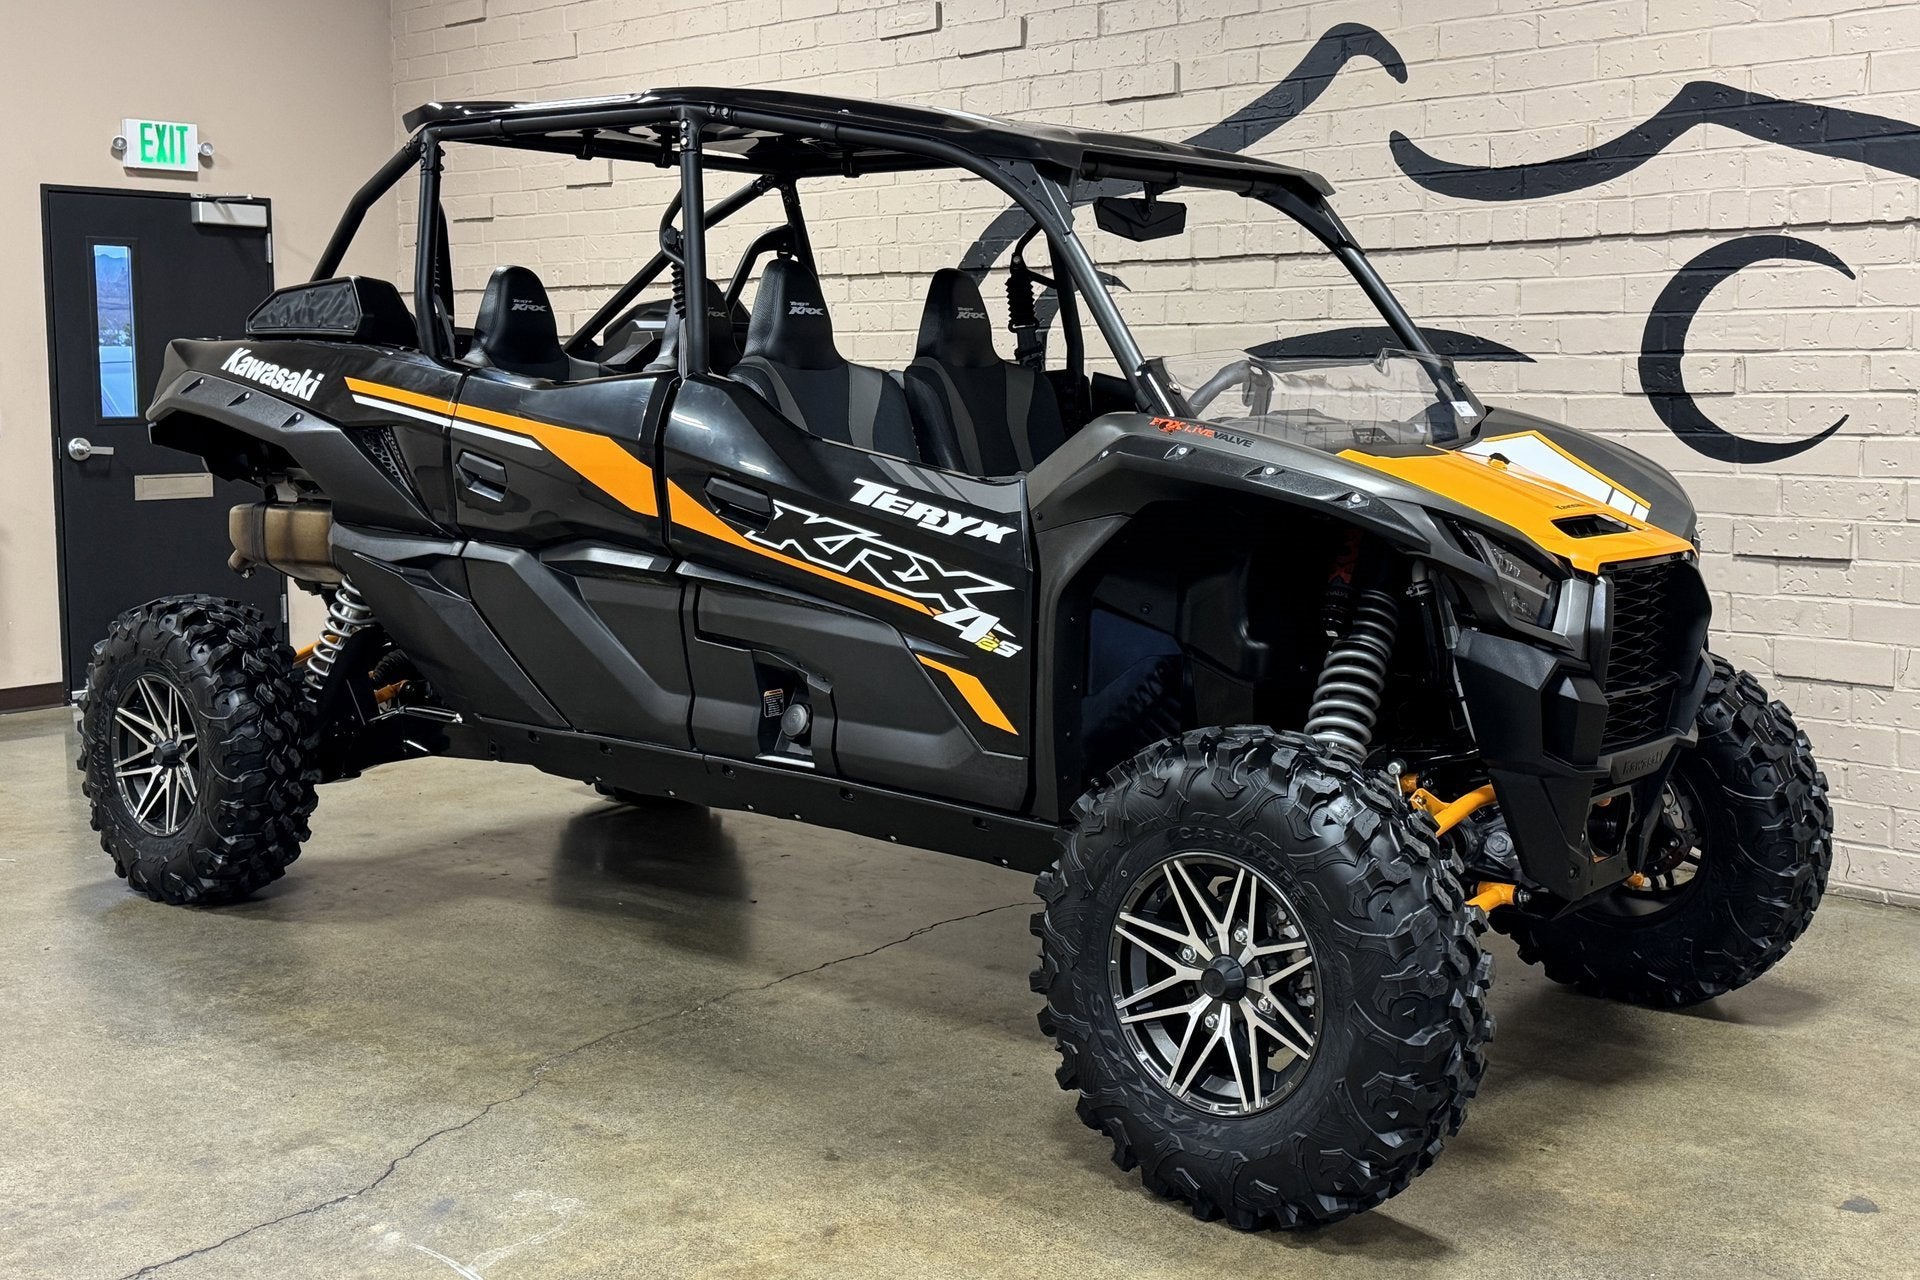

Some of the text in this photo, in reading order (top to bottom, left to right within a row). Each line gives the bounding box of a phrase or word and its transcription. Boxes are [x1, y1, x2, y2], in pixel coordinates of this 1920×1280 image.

[140, 122, 188, 165] EXIT
[789, 306, 823, 315] KRX
[221, 347, 324, 401] Kawasaki
[1149, 417, 1186, 434] FOX
[850, 478, 1017, 543] TERYX
